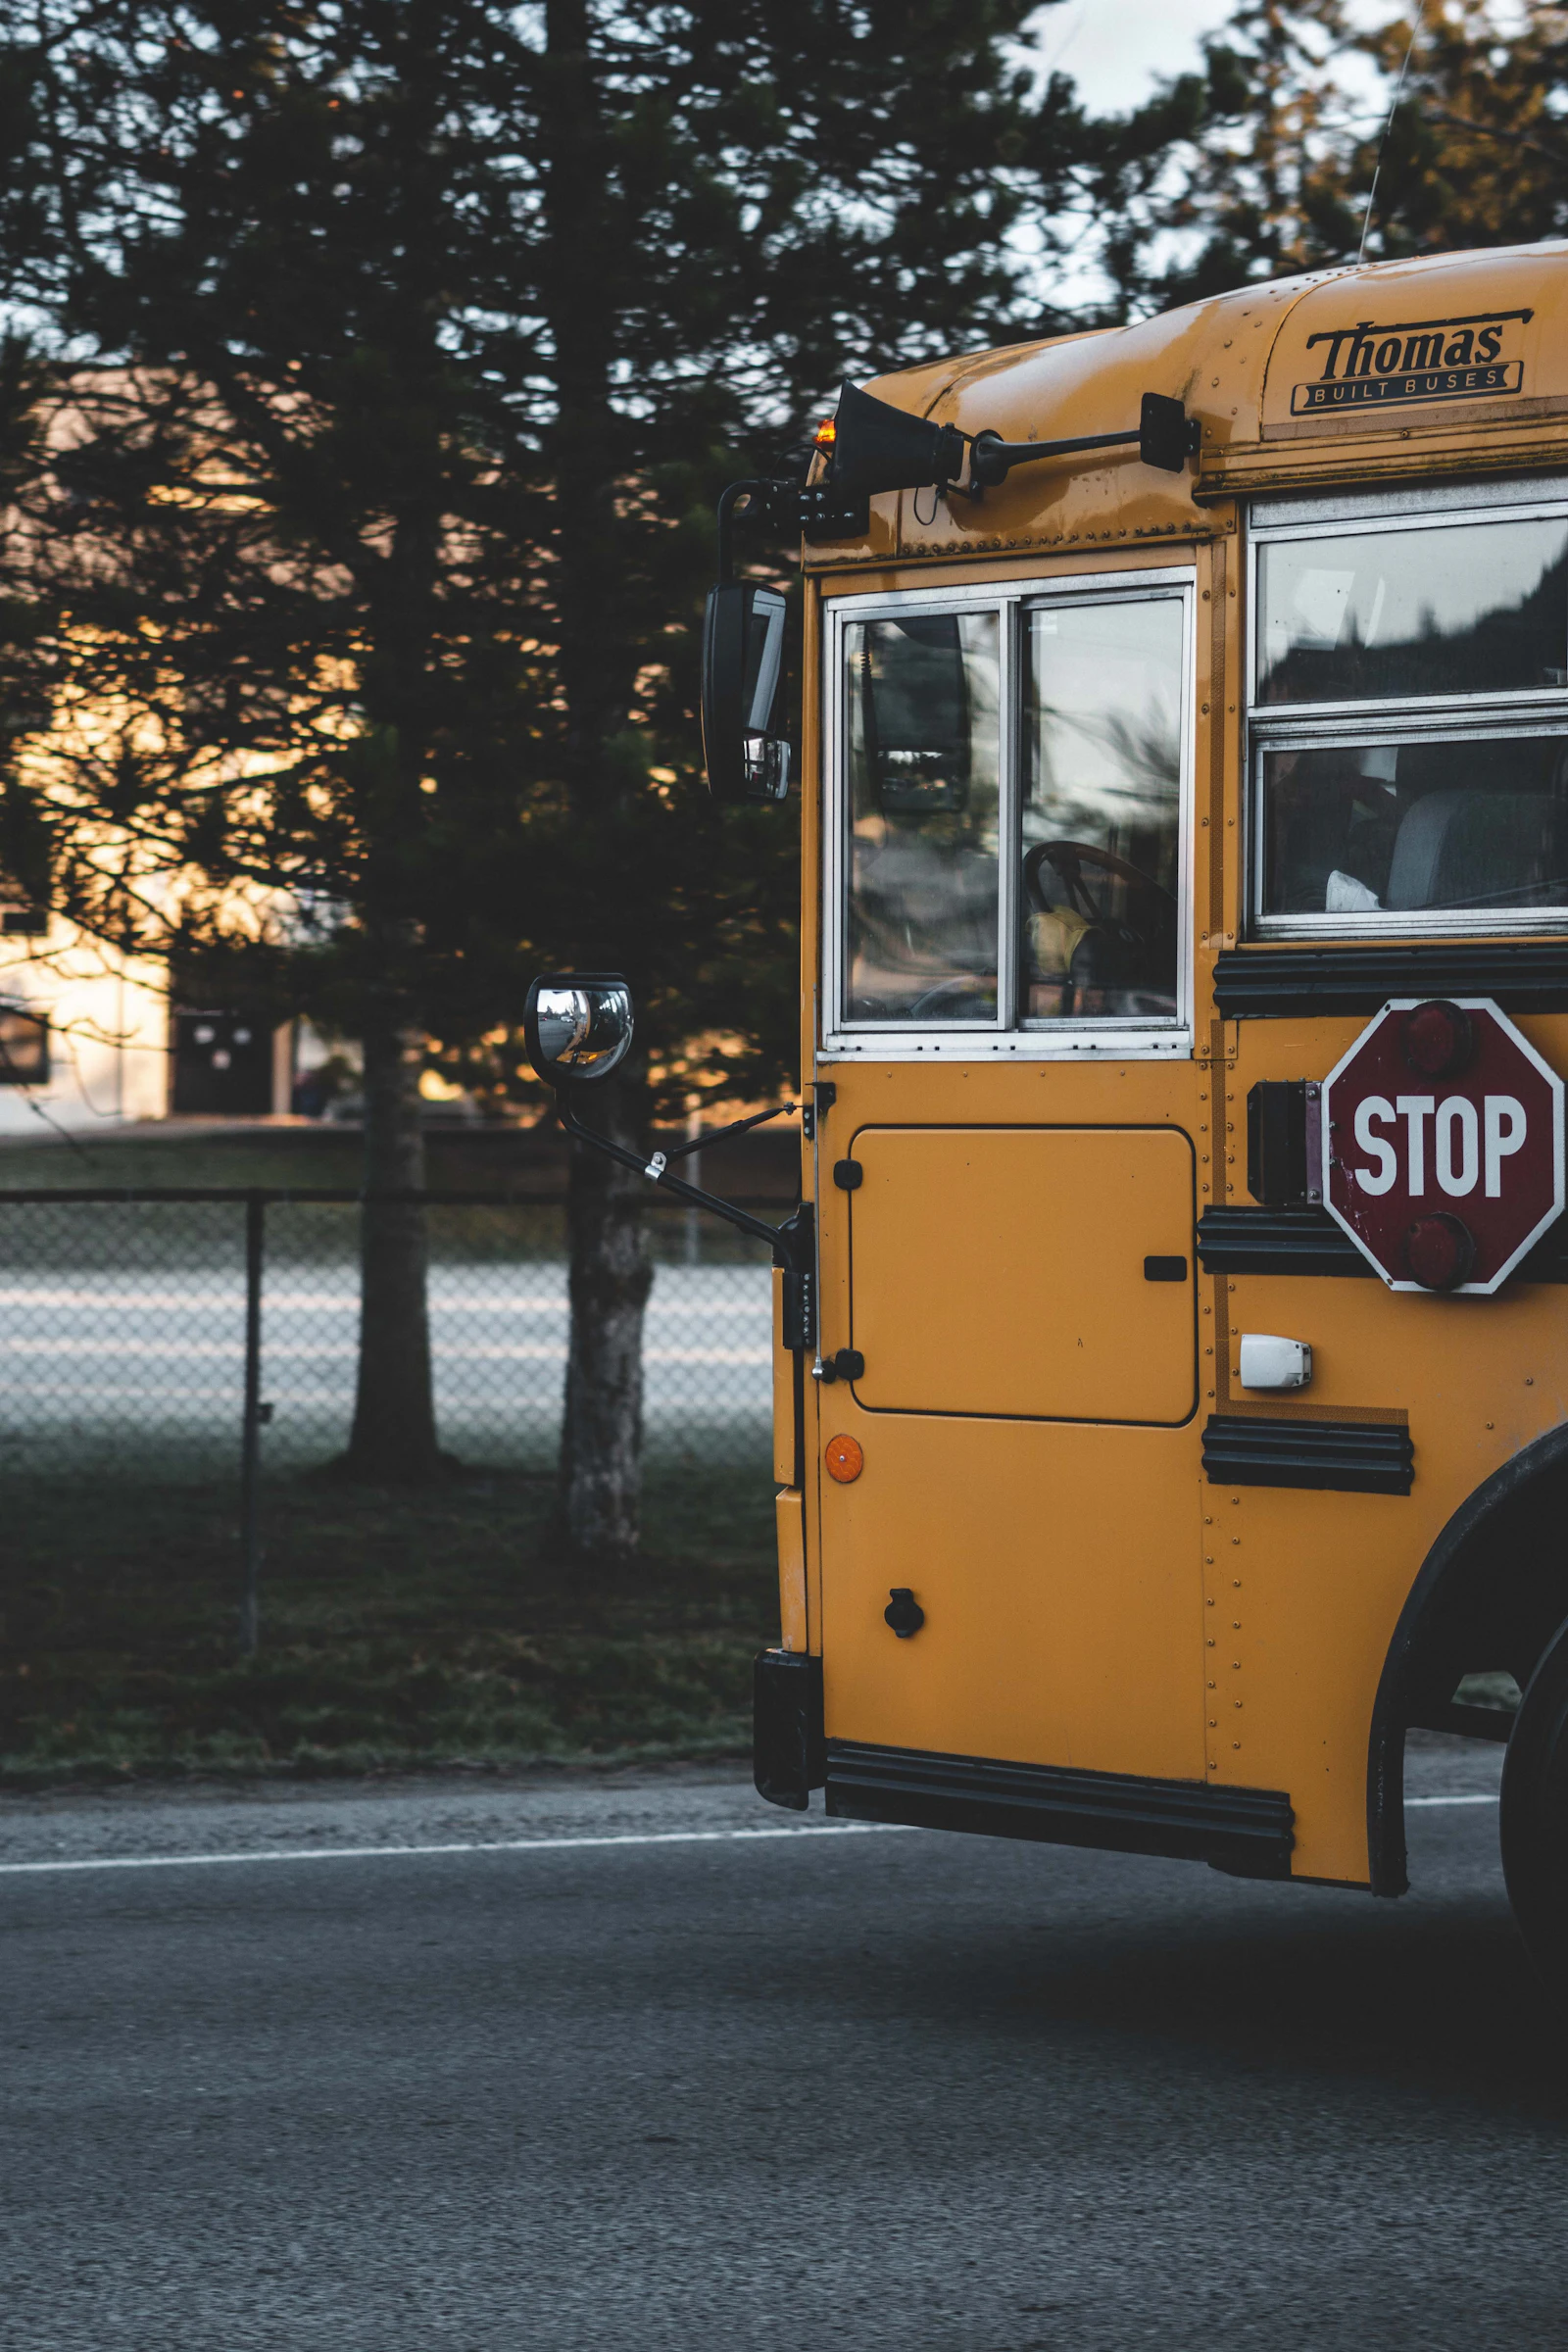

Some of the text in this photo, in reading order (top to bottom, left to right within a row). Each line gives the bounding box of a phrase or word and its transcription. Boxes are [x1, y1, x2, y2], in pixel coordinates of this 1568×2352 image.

[1306, 308, 1534, 380] Thomas
[1314, 369, 1497, 403] BUILT BUSES
[1353, 1095, 1528, 1199] STOP
